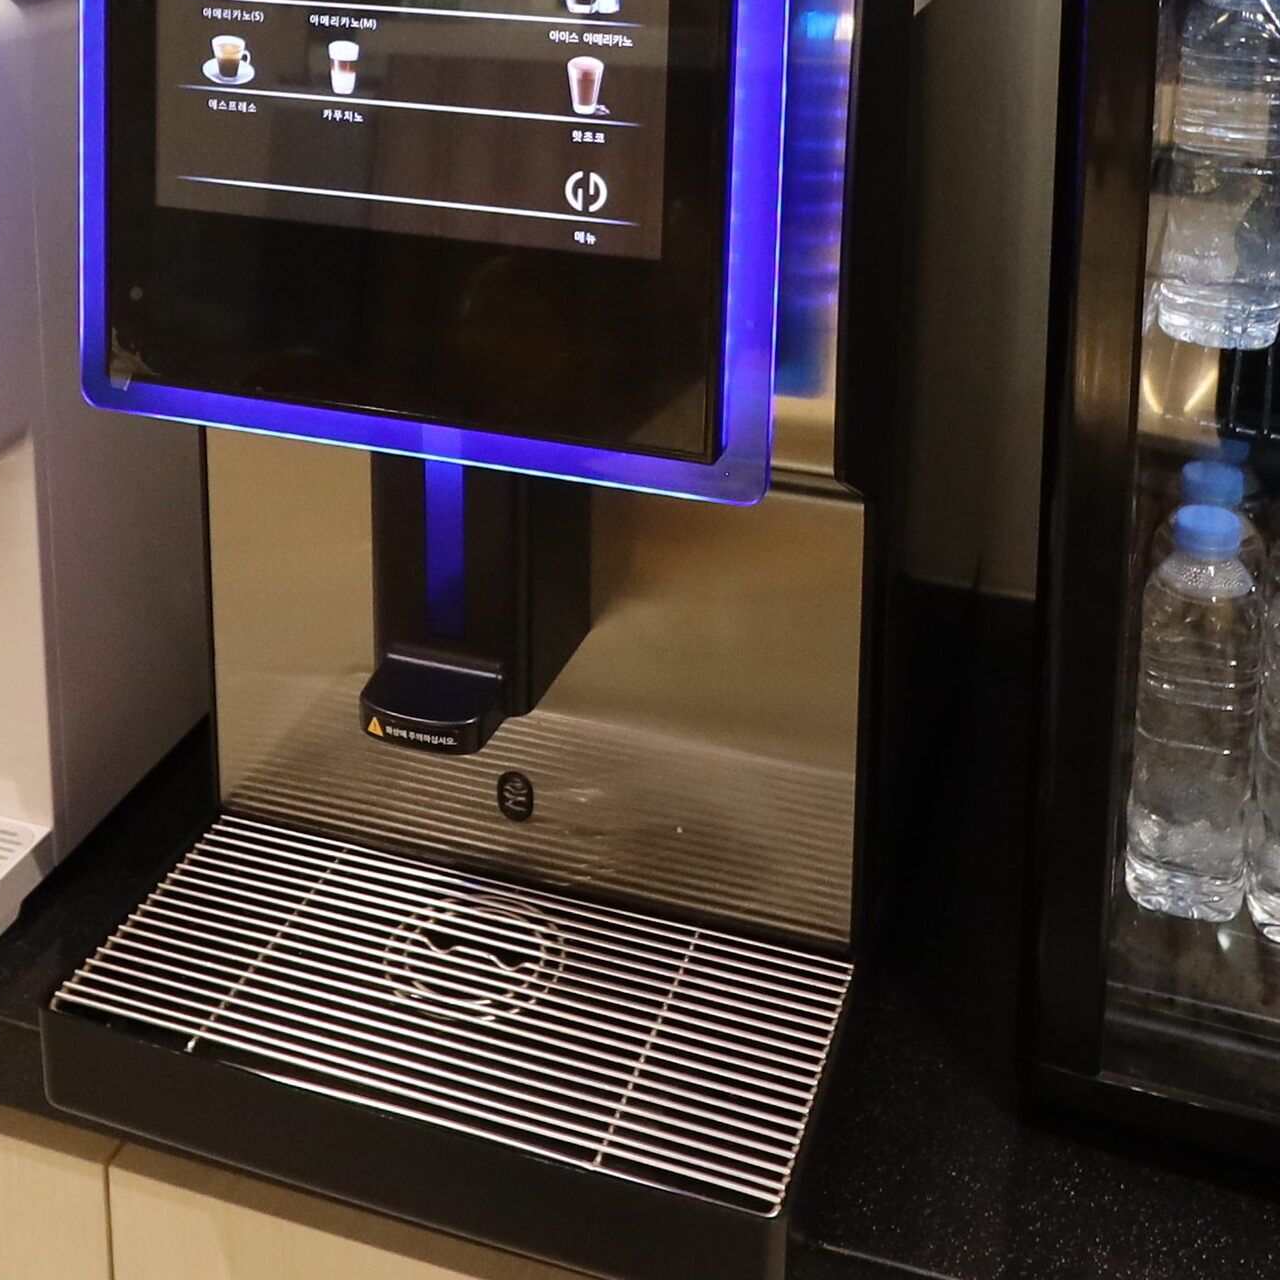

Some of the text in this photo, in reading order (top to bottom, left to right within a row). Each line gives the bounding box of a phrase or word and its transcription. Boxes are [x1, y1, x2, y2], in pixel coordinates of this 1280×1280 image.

[202, 6, 264, 23] 아메리카노(S)
[309, 13, 378, 30] 아메리카노(M)
[549, 30, 634, 47] 아이스 아메리카노
[207, 98, 257, 114] 에스프레소
[572, 129, 606, 144] 핫초코
[573, 230, 597, 246] 메뉴
